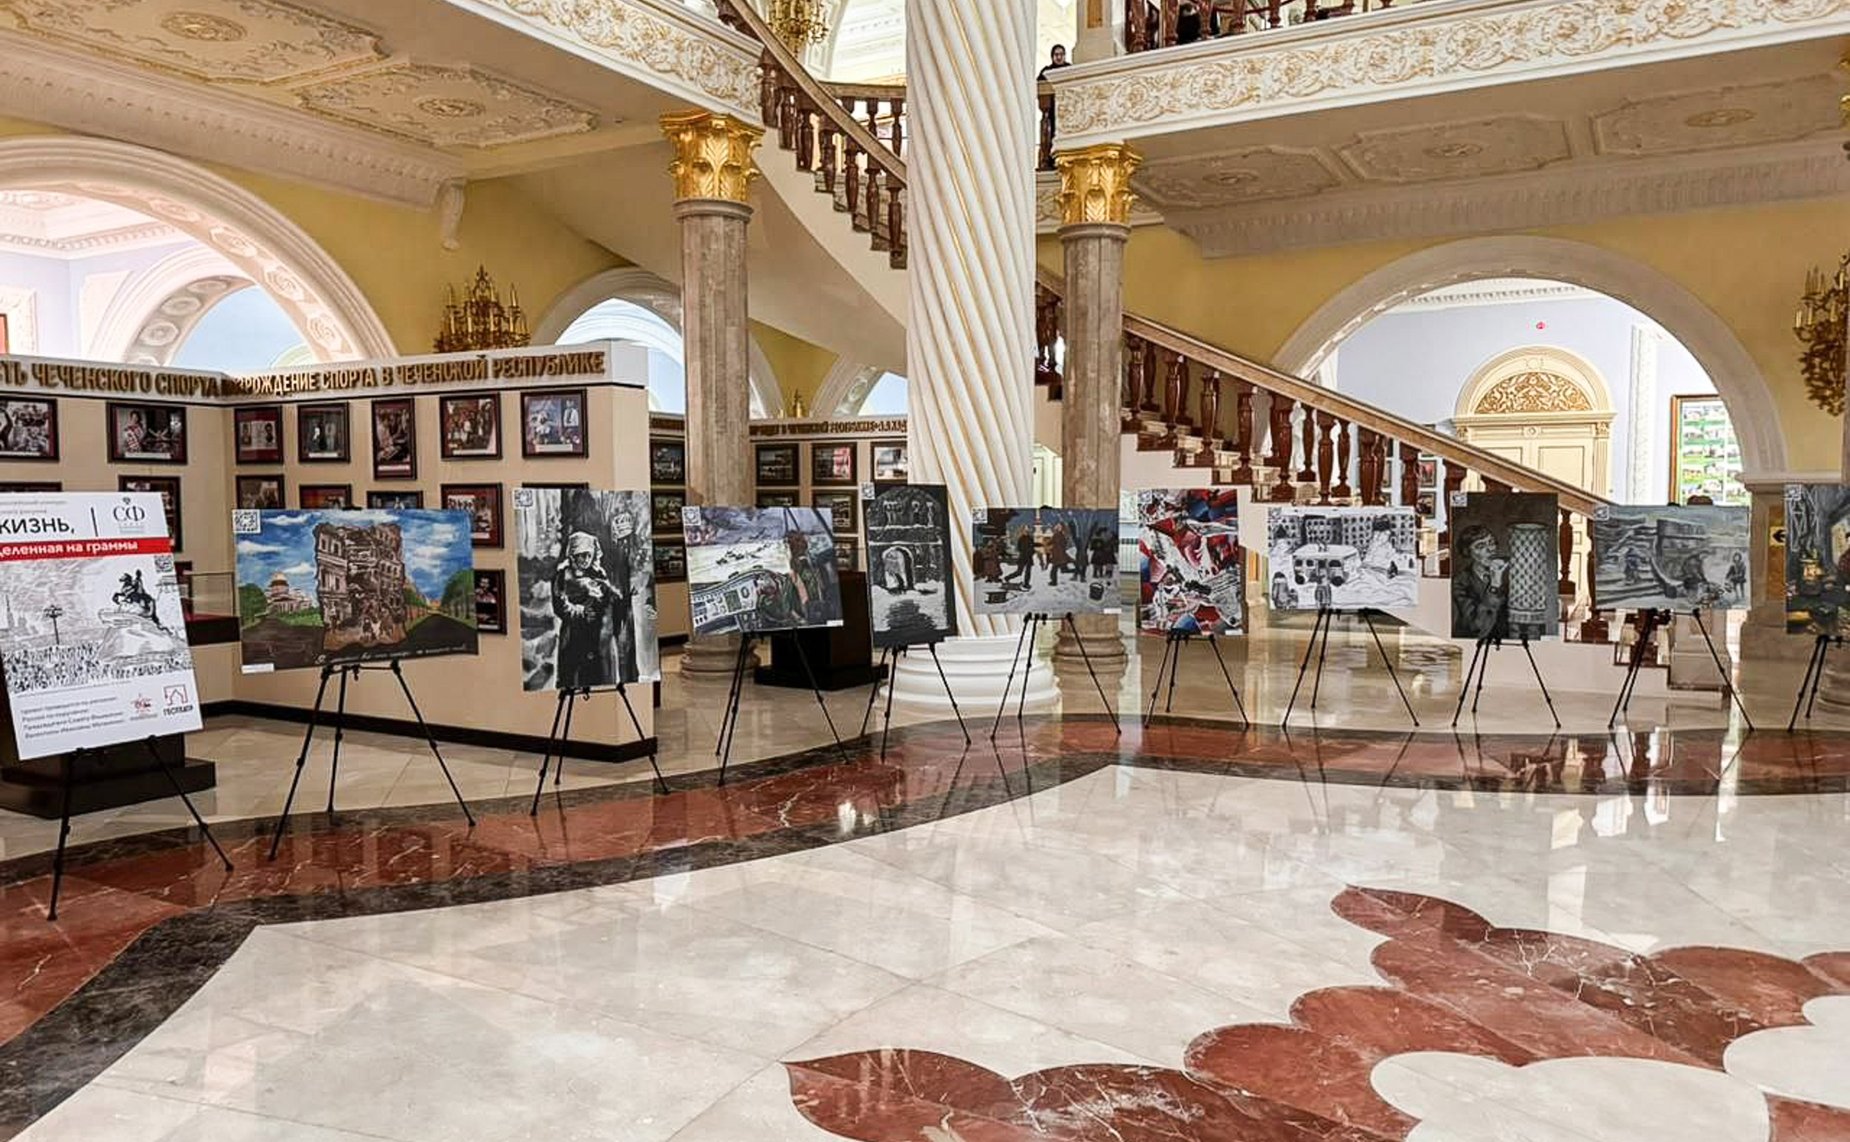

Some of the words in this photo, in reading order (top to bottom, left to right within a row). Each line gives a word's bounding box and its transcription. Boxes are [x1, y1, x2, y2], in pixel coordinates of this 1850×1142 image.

[0, 361, 28, 386] ТЬ
[31, 363, 151, 392] ЧЕЧЕНСКОГО
[154, 372, 219, 397] СПОРТА
[221, 372, 321, 396] ЗРОЖДЕНИЕ
[322, 365, 378, 391] СПОРТА
[382, 367, 393, 385] В
[396, 355, 487, 385] ЧЕЧЕНСКОЙ
[491, 352, 605, 376] РЕСПУБЛИКЕ
[66, 544, 83, 553] на
[86, 541, 138, 553] граммы
